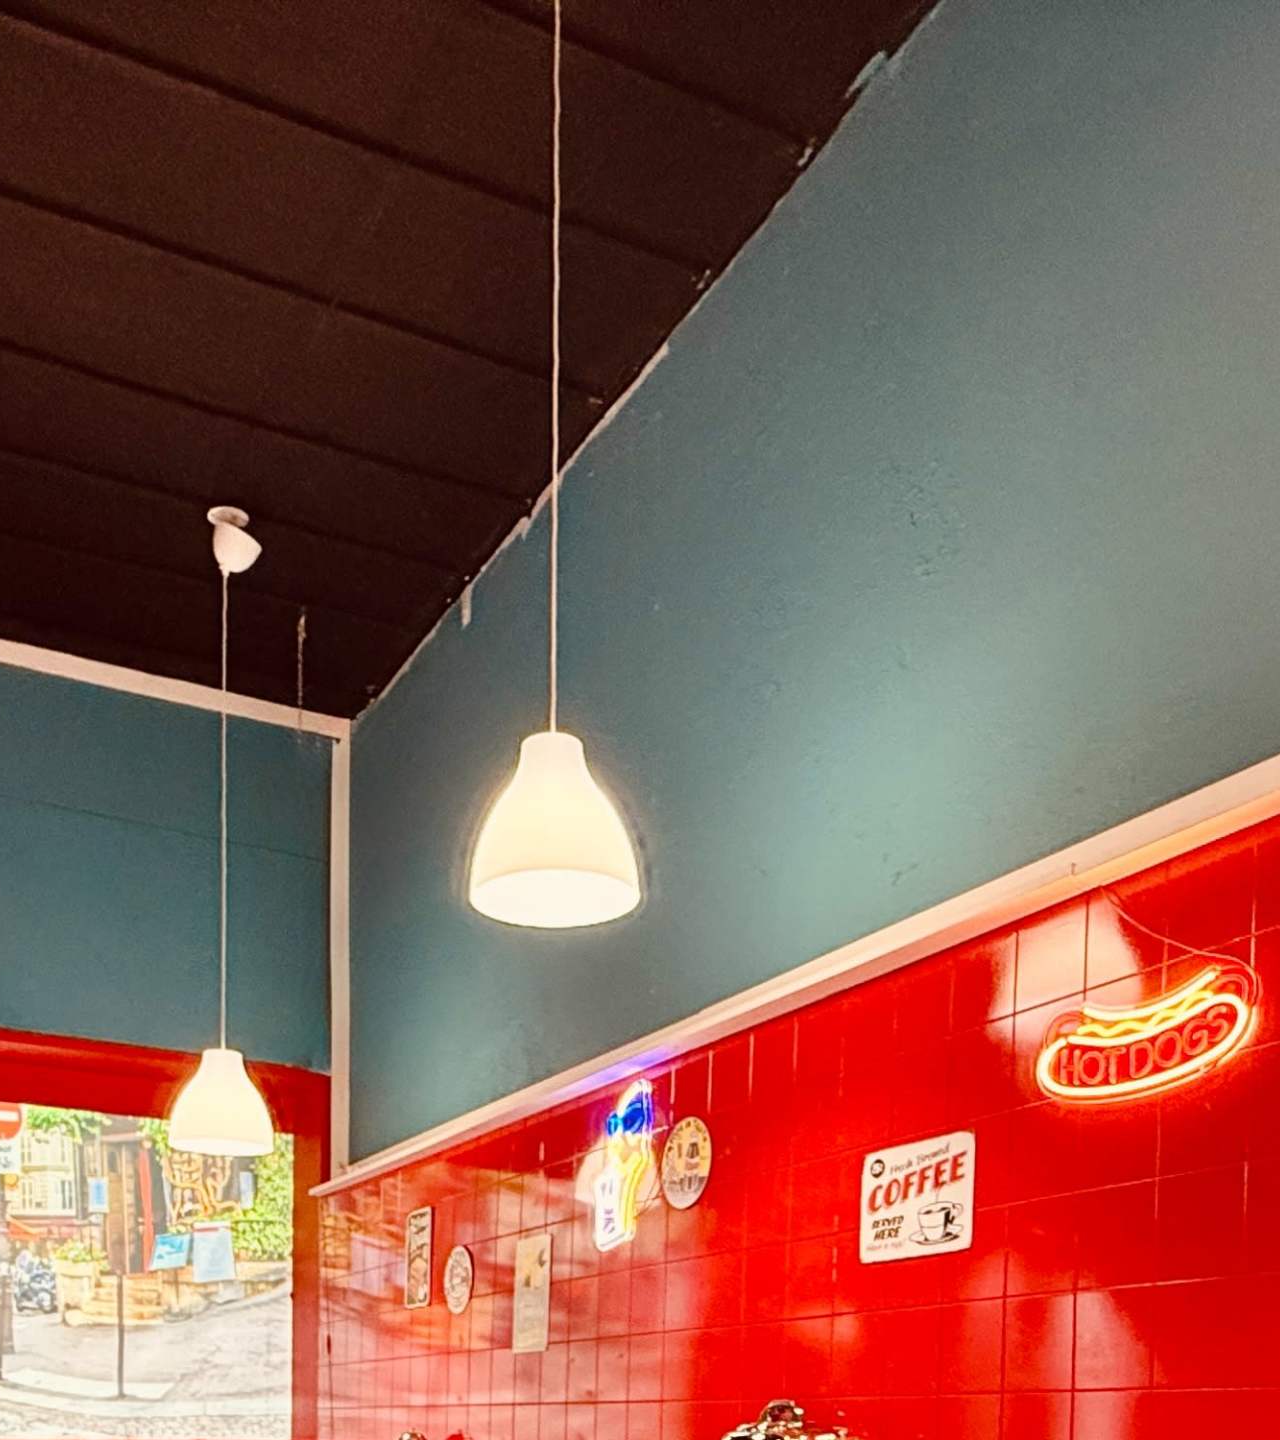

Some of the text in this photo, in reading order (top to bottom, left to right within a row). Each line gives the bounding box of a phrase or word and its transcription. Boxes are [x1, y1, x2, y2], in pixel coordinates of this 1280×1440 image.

[1060, 1005, 1229, 1085] HOT DOGS
[868, 1151, 967, 1213] COFFEE
[872, 1215, 904, 1229] SERVED
[873, 1226, 901, 1241] HERE
